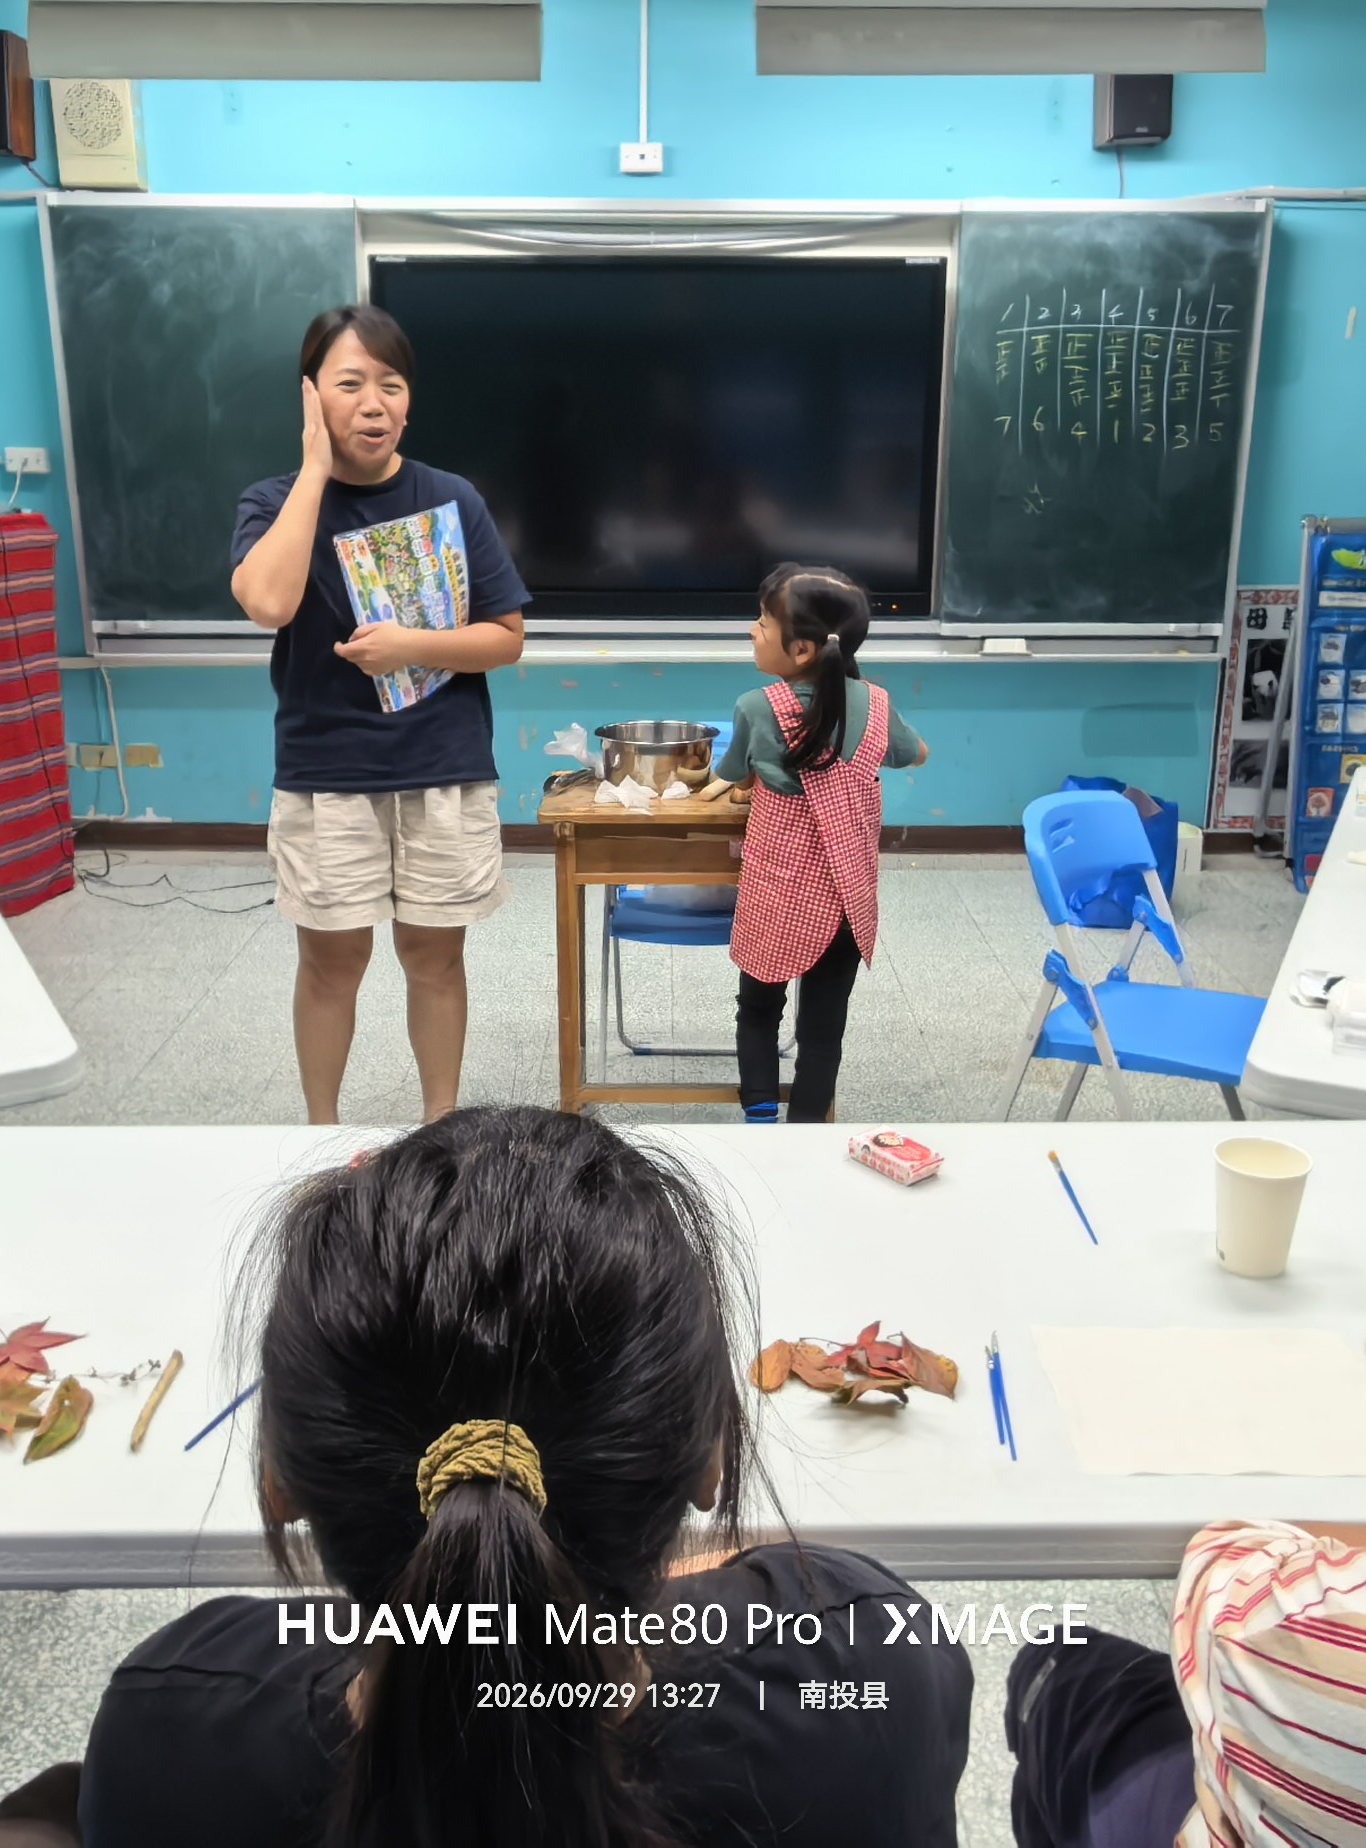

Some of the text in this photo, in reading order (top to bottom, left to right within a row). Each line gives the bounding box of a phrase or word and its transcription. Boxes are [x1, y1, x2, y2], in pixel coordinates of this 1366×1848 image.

[1037, 307, 1052, 320] 2
[1146, 307, 1159, 321] 5
[1185, 301, 1197, 325] 6
[1215, 304, 1234, 327] 7
[994, 416, 1012, 437] 7
[1032, 405, 1045, 432] 6
[1070, 421, 1087, 445] 4
[1142, 422, 1156, 443] 2
[1172, 424, 1190, 450] 3
[1209, 422, 1224, 442] 5
